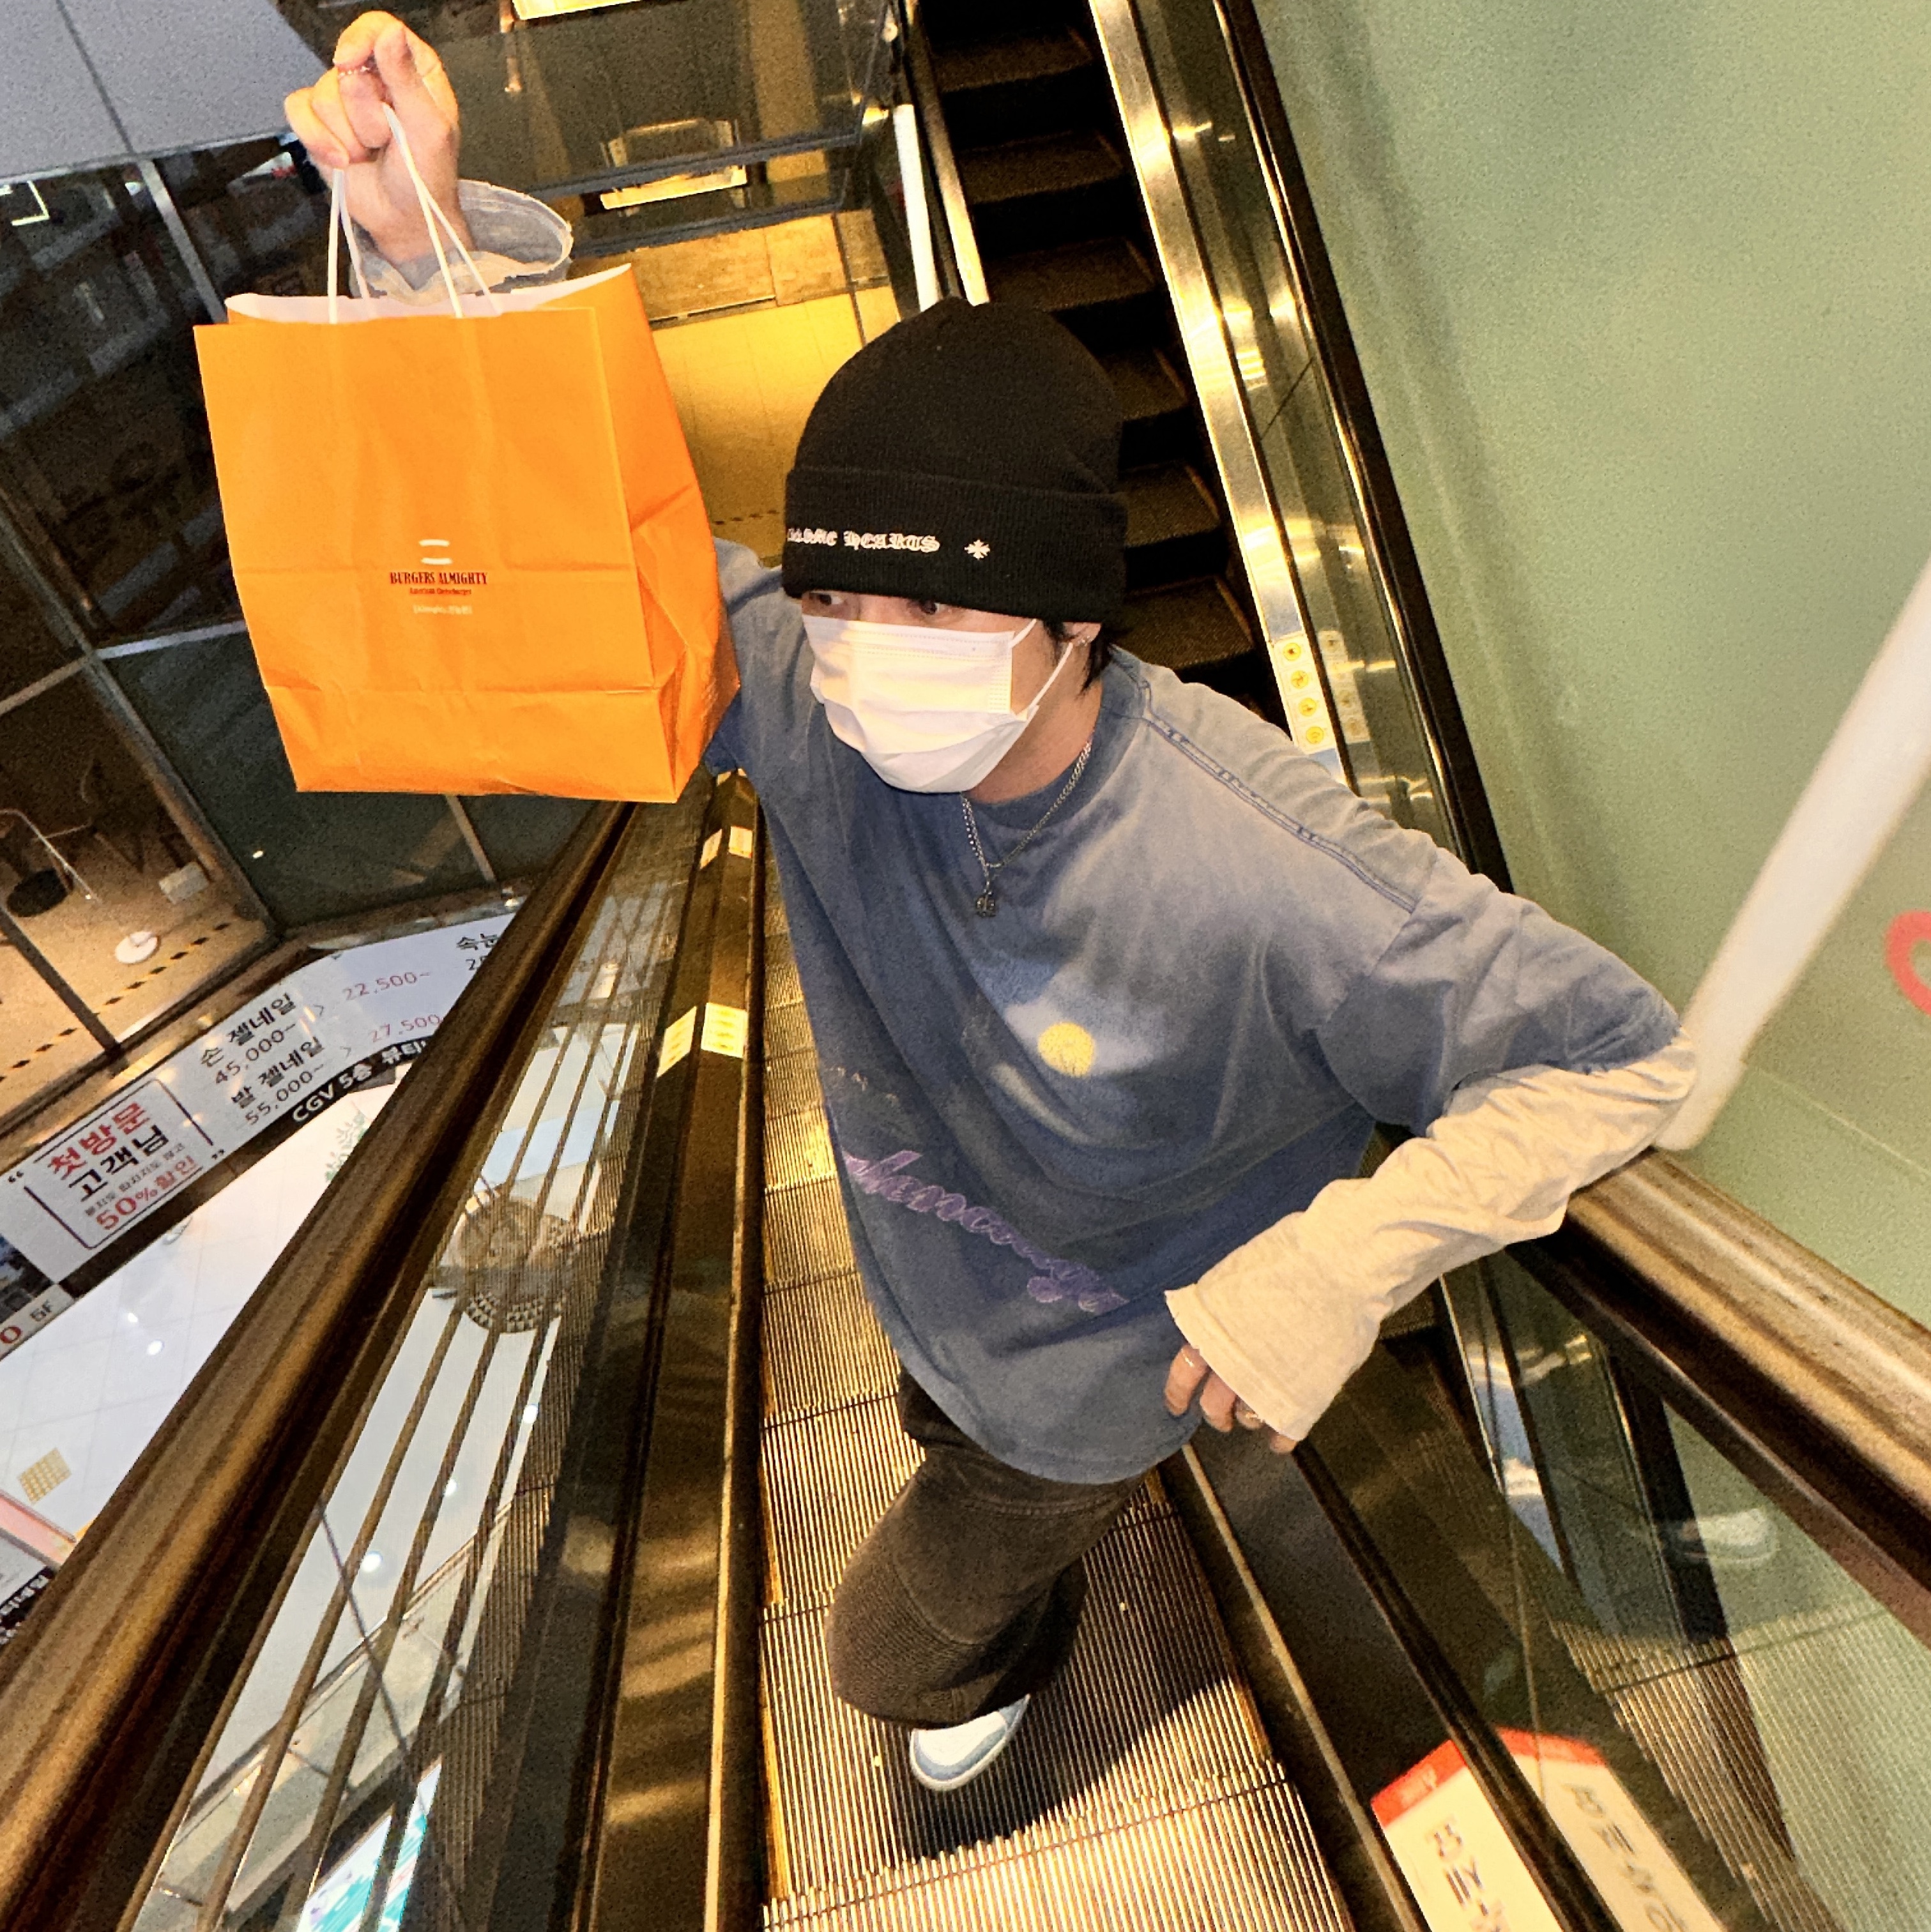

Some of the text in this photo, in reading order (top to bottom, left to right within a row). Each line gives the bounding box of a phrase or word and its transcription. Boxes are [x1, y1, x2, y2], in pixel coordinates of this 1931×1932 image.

[389, 571, 488, 585] BURGERS ALMIGHTY
[201, 993, 296, 1067] 손 젤네일
[231, 1036, 325, 1109] 발 젤네일
[293, 1083, 335, 1122] CGV
[47, 1102, 150, 1180] 첫방문
[68, 1125, 169, 1202] 고객님
